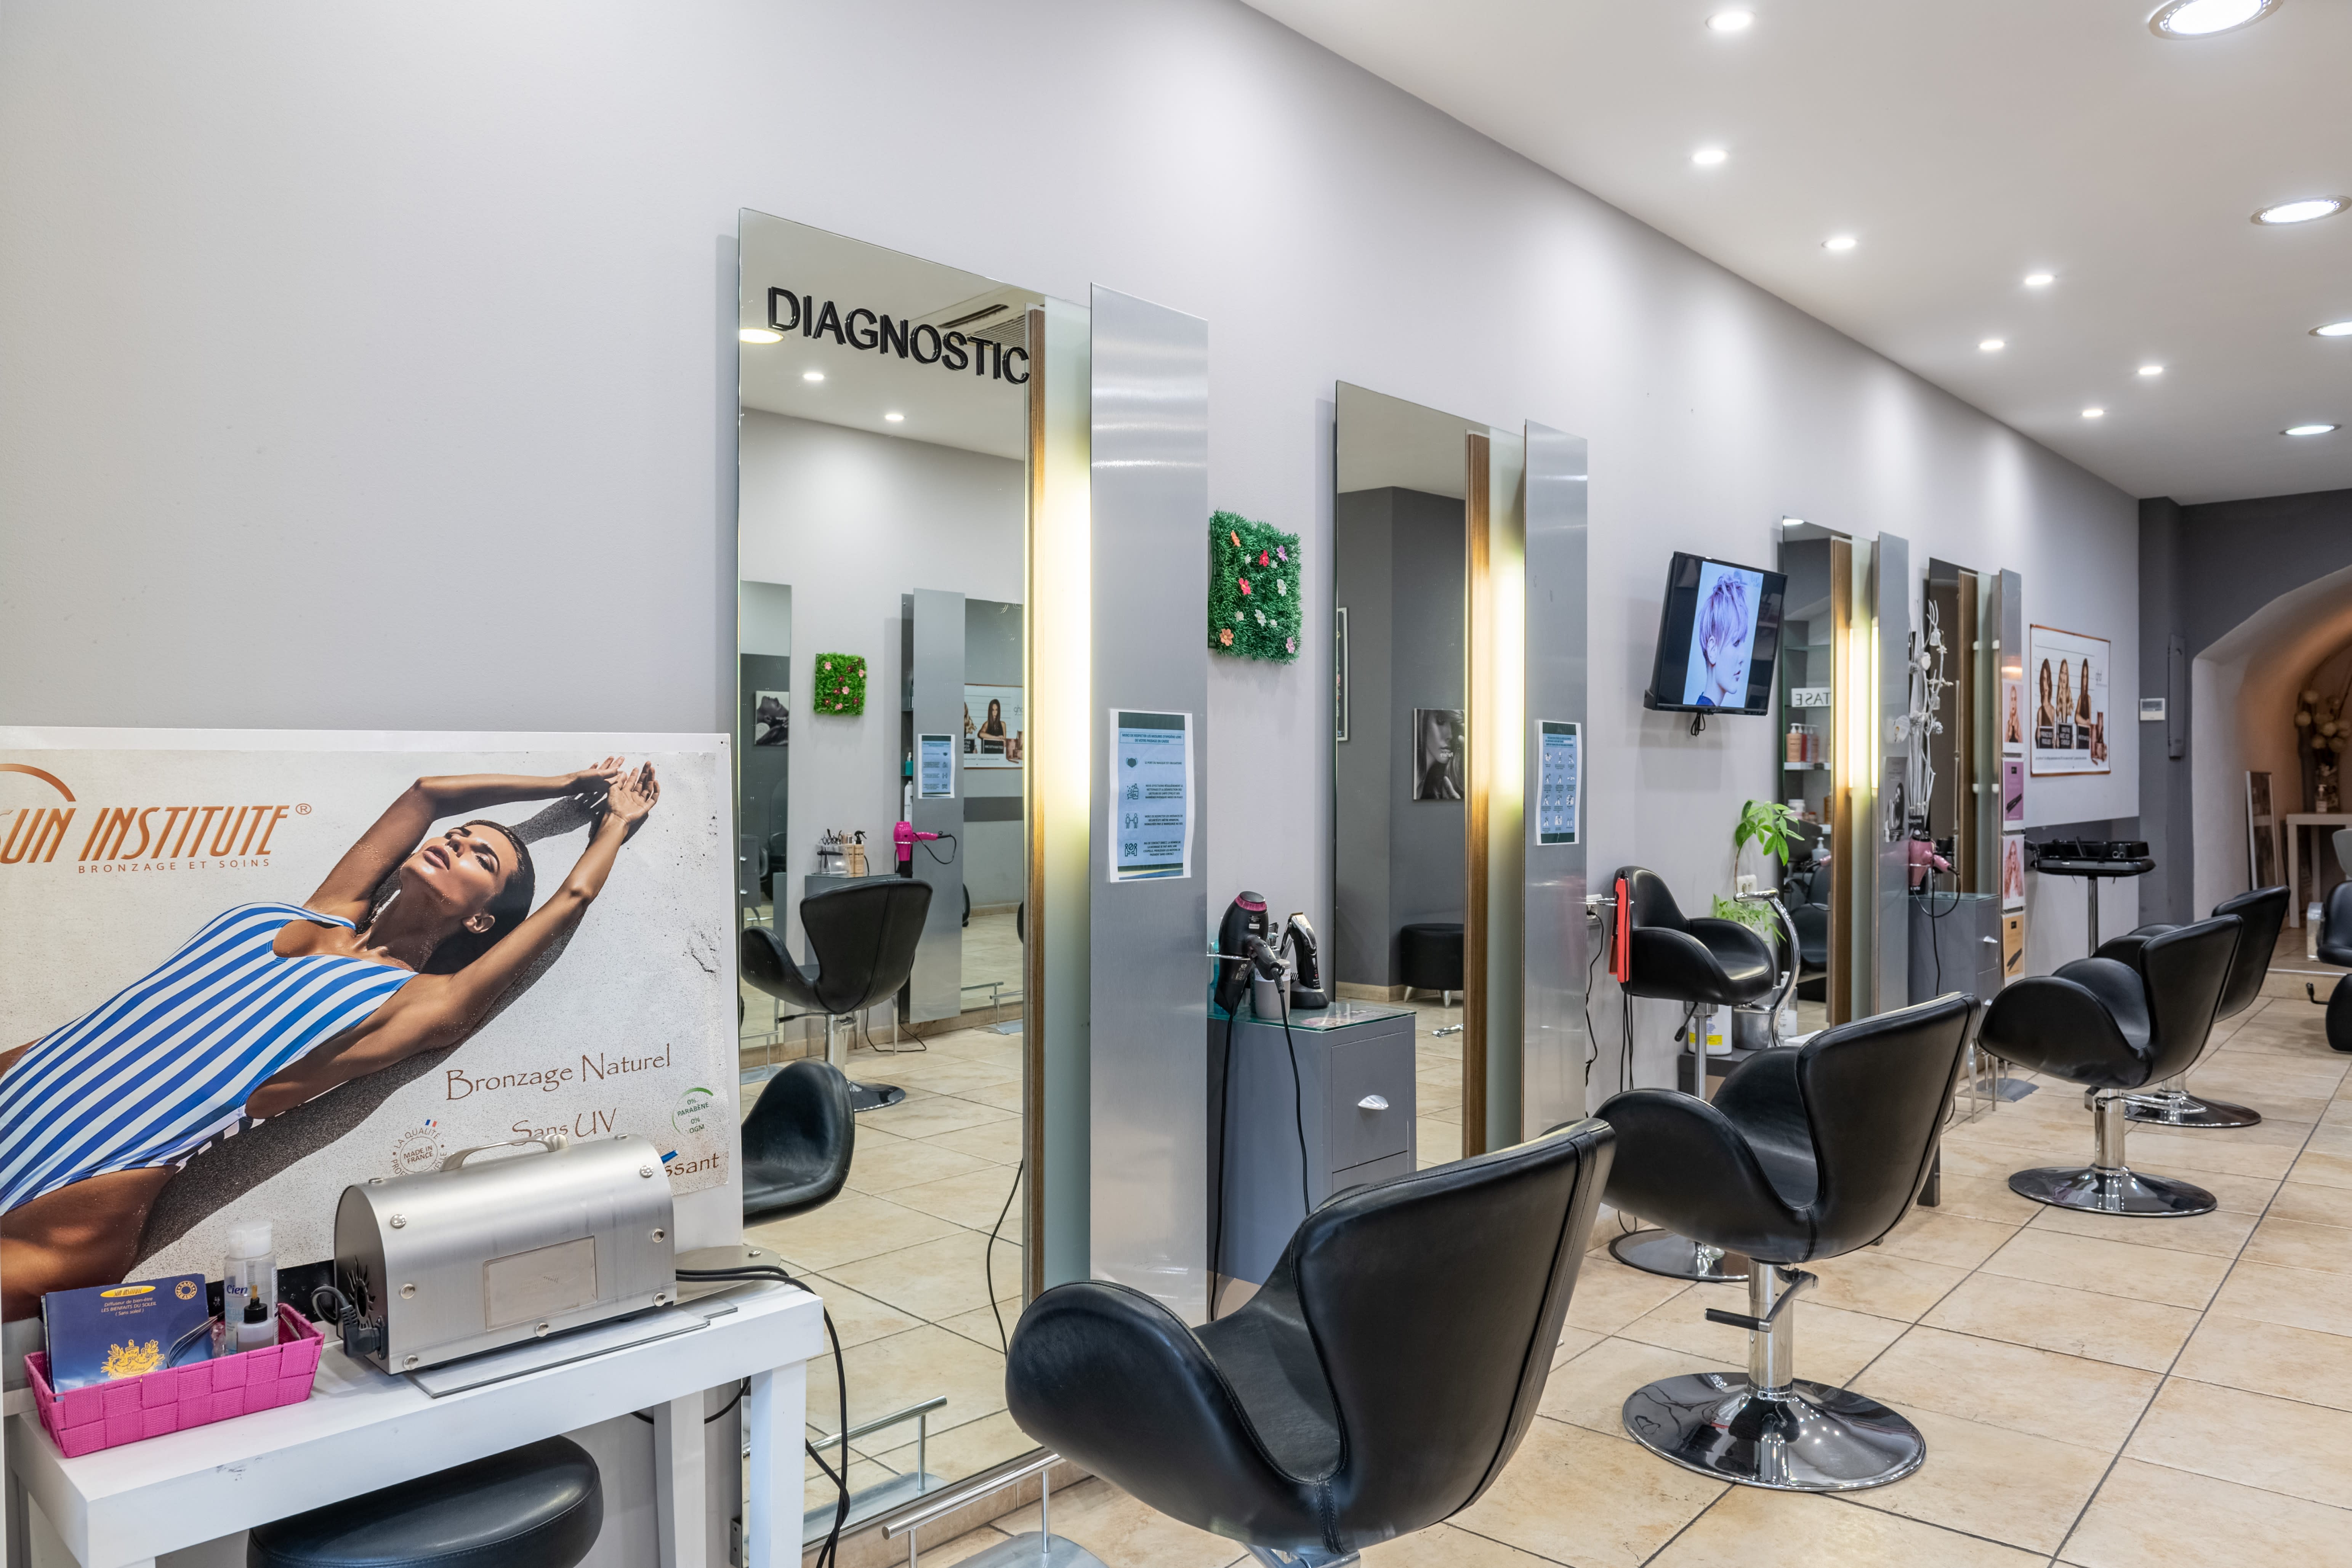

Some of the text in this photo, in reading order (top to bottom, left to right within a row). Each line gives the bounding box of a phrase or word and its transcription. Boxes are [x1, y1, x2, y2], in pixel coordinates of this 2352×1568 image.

[767, 287, 1030, 384] DIAGNOSTIC
[78, 805, 290, 862] INSTITUTE
[79, 858, 269, 874] BRONZAGE ET SOINS
[446, 1043, 671, 1101] Bronzage Naturel
[512, 1108, 617, 1146] Sans UV
[689, 1124, 705, 1133] OGM
[394, 1127, 442, 1149] LA QUALITÉ
[403, 1148, 424, 1159] MADE
[407, 1151, 433, 1164] FRANCE
[226, 1285, 248, 1294] Cien
